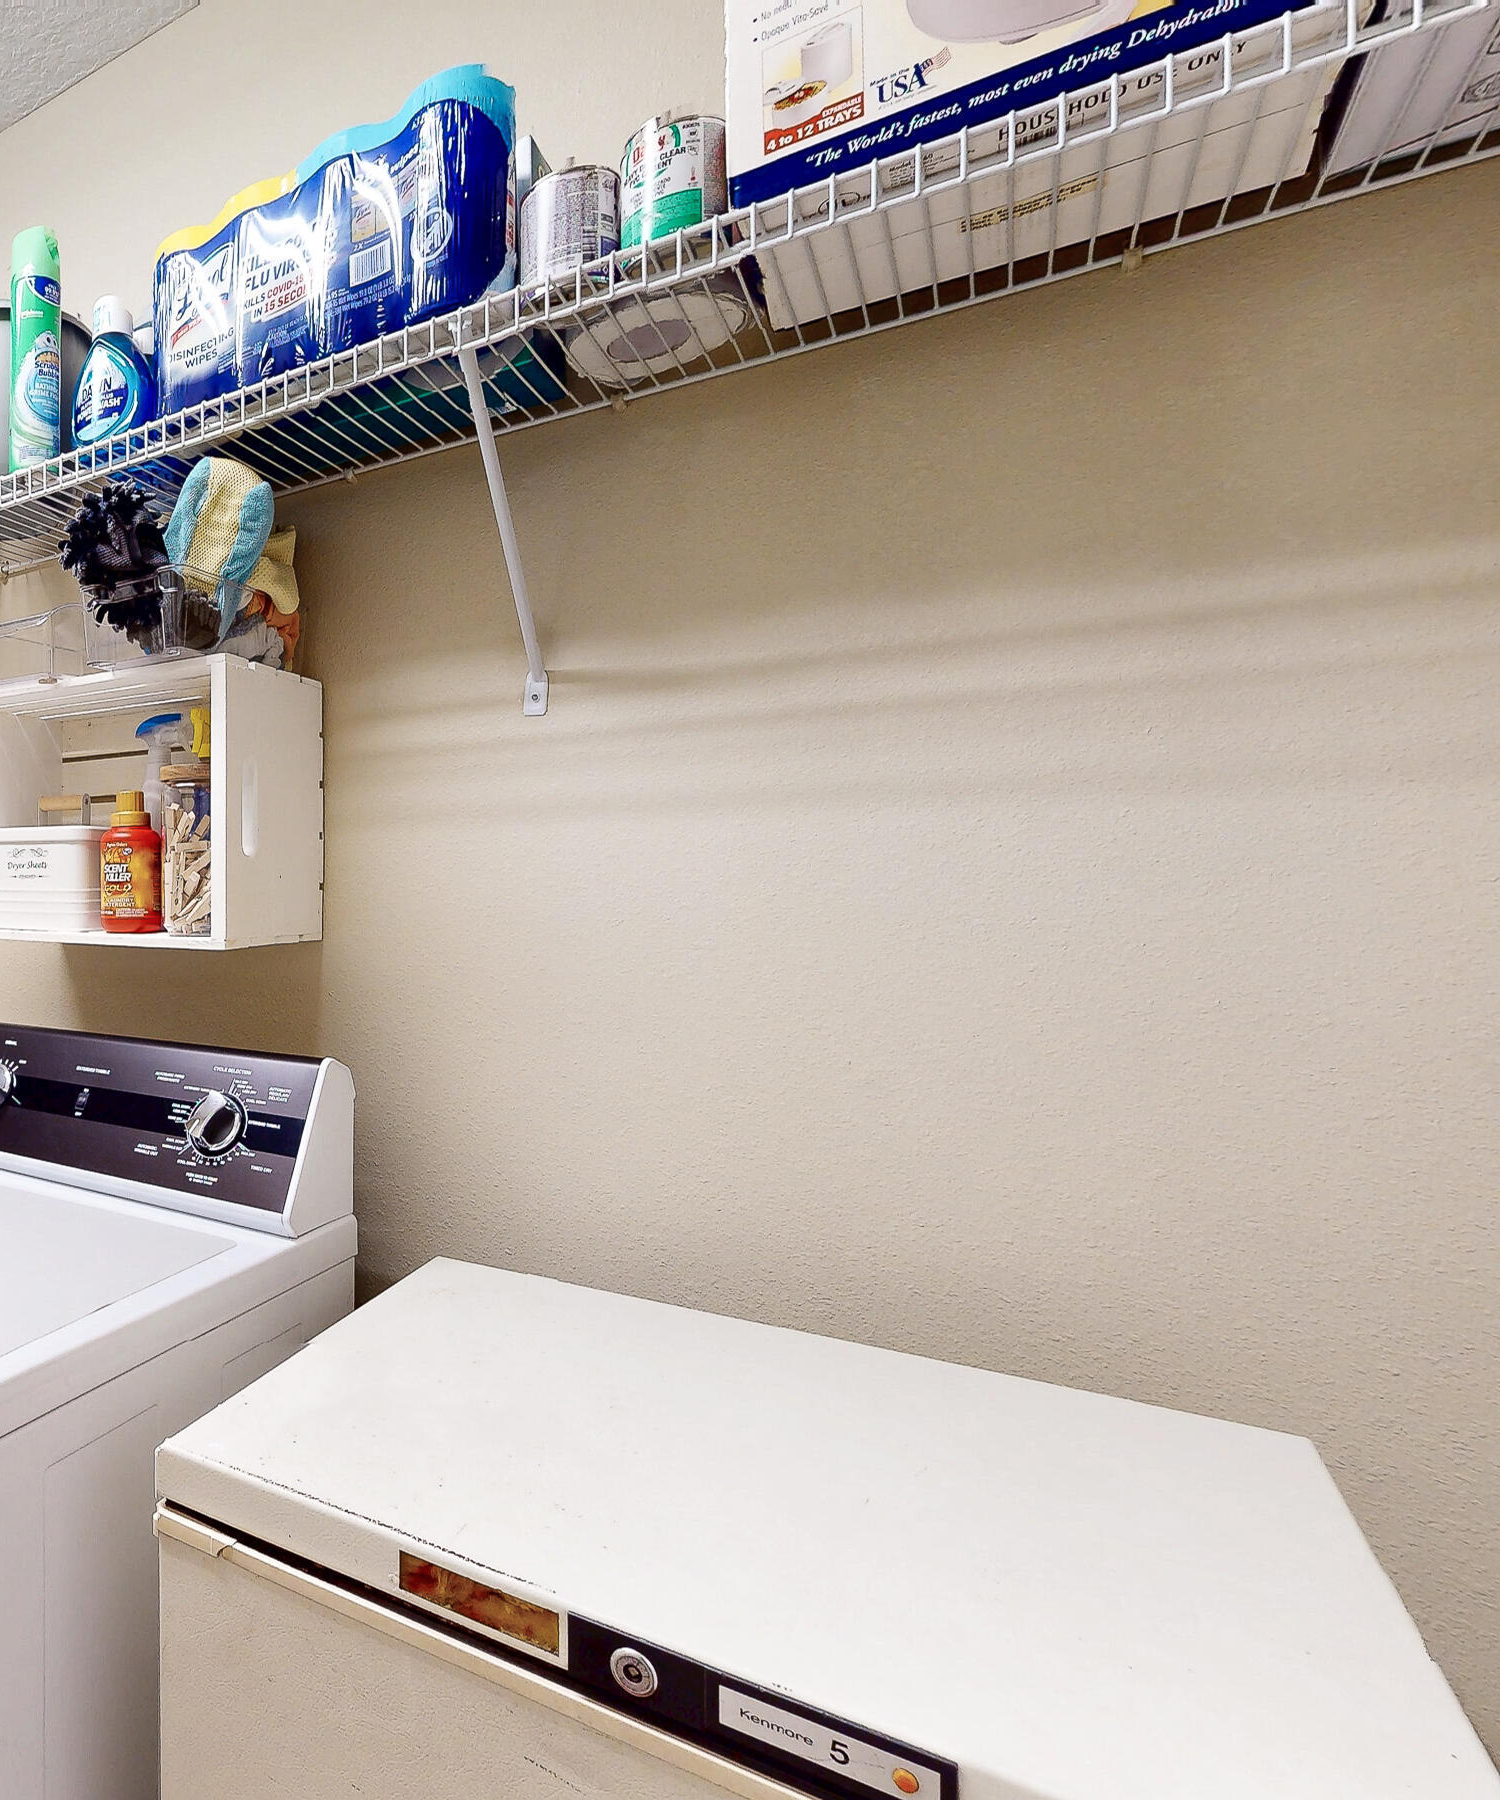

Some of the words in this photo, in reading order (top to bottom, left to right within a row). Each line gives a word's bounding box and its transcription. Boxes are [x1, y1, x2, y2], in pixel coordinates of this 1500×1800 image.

[877, 62, 929, 105] USA
[905, 103, 963, 138] fastest,
[967, 83, 1009, 109] most
[1013, 66, 1054, 92] even
[1058, 41, 1124, 72] drying
[998, 85, 1128, 142] HOUSHOLD
[1187, 41, 1248, 72] ONY
[766, 138, 777, 151] 4
[778, 134, 795, 147] to
[796, 124, 815, 138] 12
[816, 106, 863, 132] TRAYS
[659, 146, 687, 162] CLEAR
[245, 268, 270, 293] FLU
[253, 306, 263, 319] IN
[264, 300, 276, 314] 15
[34, 360, 60, 373] Scrubb
[184, 347, 219, 369] WIPES
[7, 861, 25, 872] Dryer
[26, 860, 47, 870] Sheets
[103, 863, 129, 873] SCENT
[105, 872, 132, 883] KILLER
[104, 883, 133, 896] GOLD
[739, 1707, 814, 1747] Kenmore
[829, 1738, 850, 1766] 5
